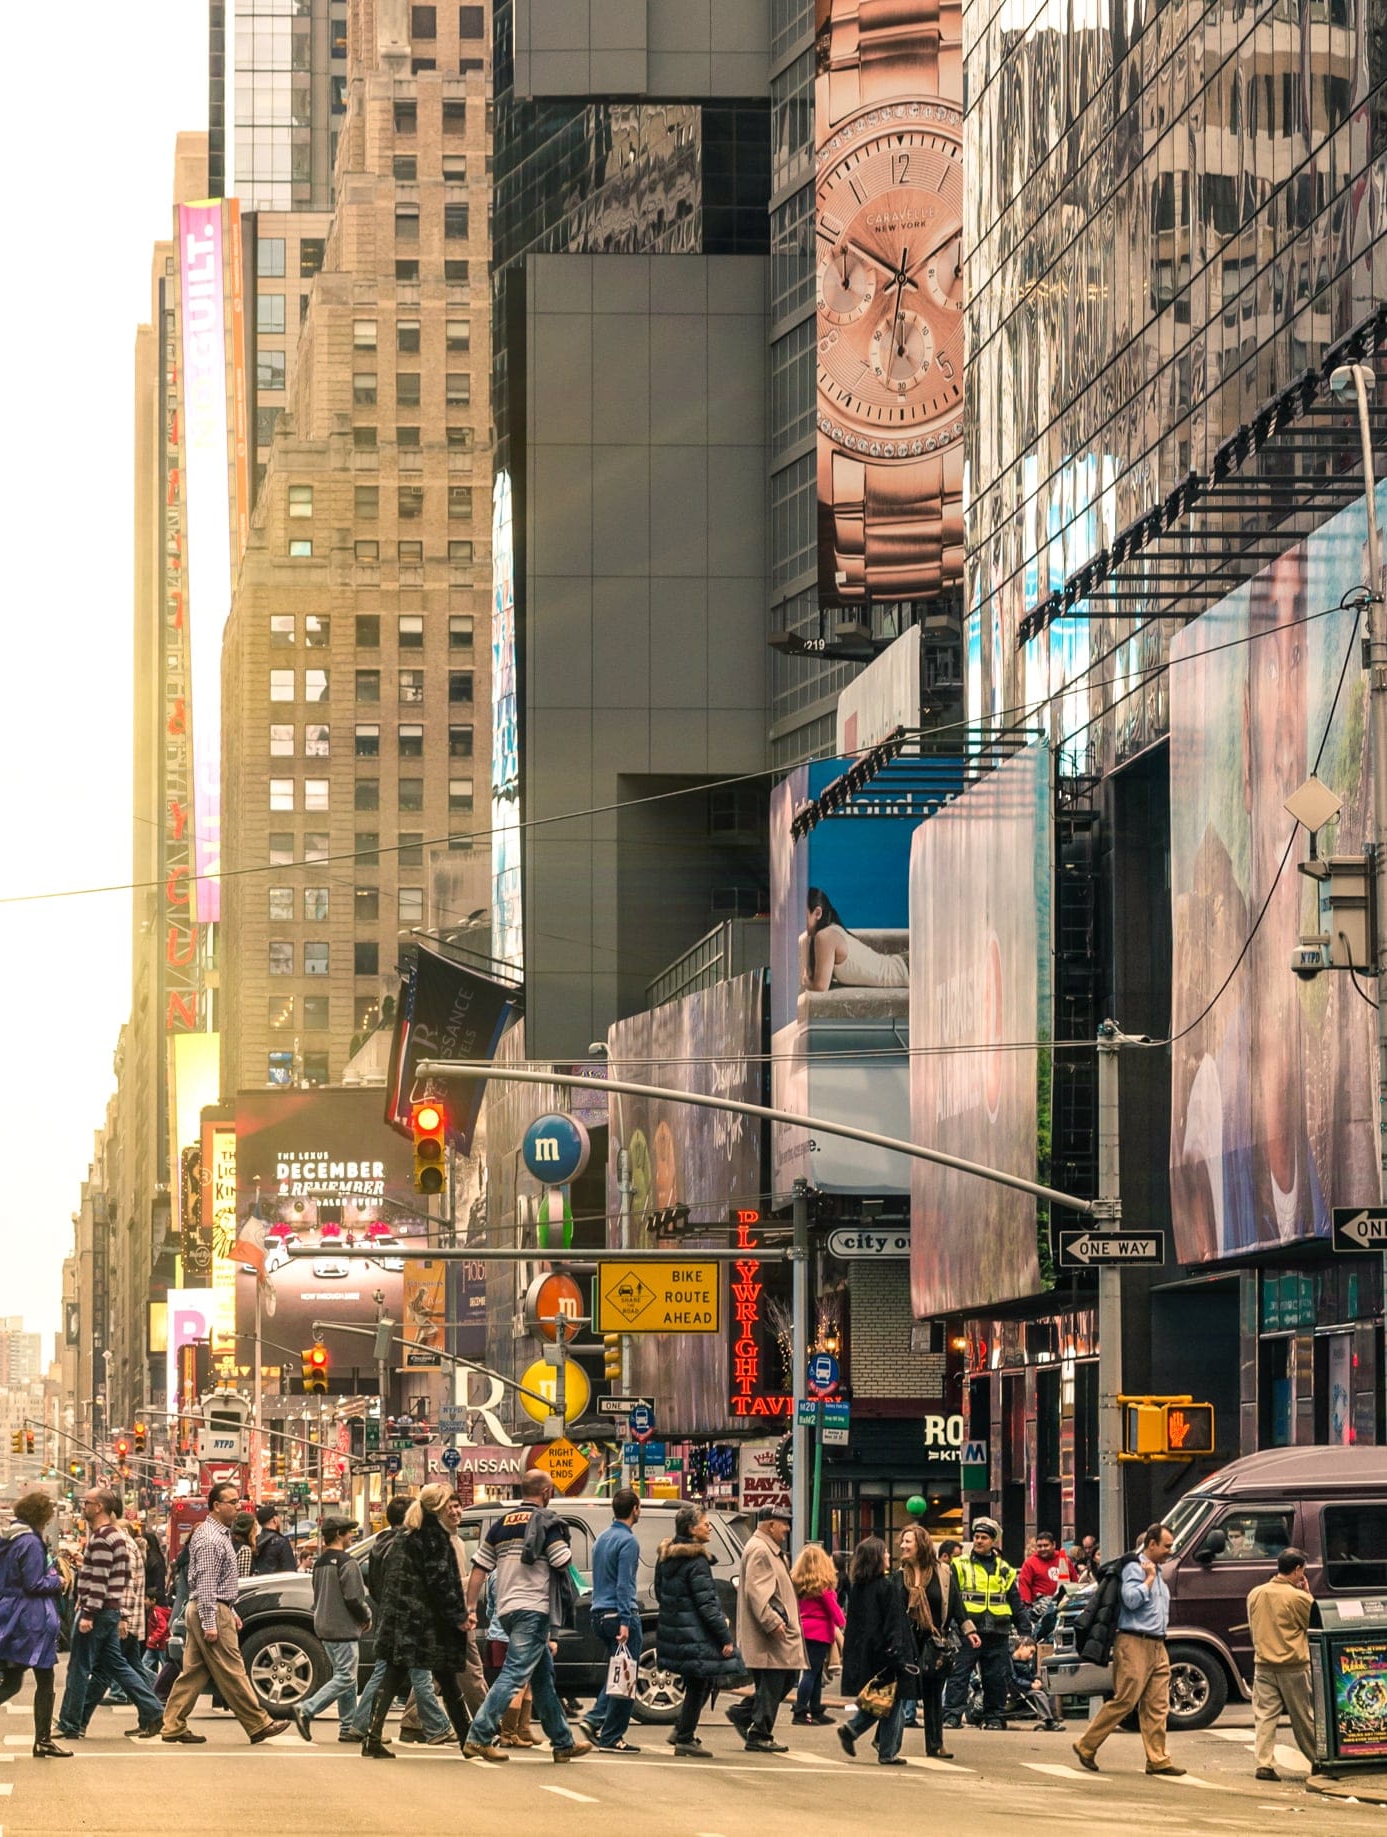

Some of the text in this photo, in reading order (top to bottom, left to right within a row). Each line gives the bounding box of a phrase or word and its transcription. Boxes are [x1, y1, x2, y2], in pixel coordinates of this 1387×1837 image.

[866, 206, 935, 226] CARAVELLE
[875, 220, 926, 233] NEW YORK
[221, 1151, 236, 1160] TH
[534, 1137, 560, 1161] m
[277, 1152, 329, 1160] THE LEXUS
[277, 1162, 385, 1179] DECEMBER
[216, 1186, 236, 1200] KIN
[291, 1181, 385, 1197] REMEMBER
[844, 1233, 891, 1252] city
[1079, 1241, 1150, 1255] ONE WAY
[672, 1270, 703, 1283] BIKE
[664, 1291, 711, 1304] ROUTE
[663, 1312, 712, 1325] AHEAD
[454, 1367, 524, 1448] R
[606, 1401, 622, 1410] ONE
[213, 1439, 235, 1449] NYPD
[548, 1448, 574, 1456] RIGHT
[549, 1459, 574, 1467] LANE
[665, 1460, 672, 1470] 9
[550, 1471, 574, 1479] ENDS
[743, 1494, 792, 1508] PIZZA
